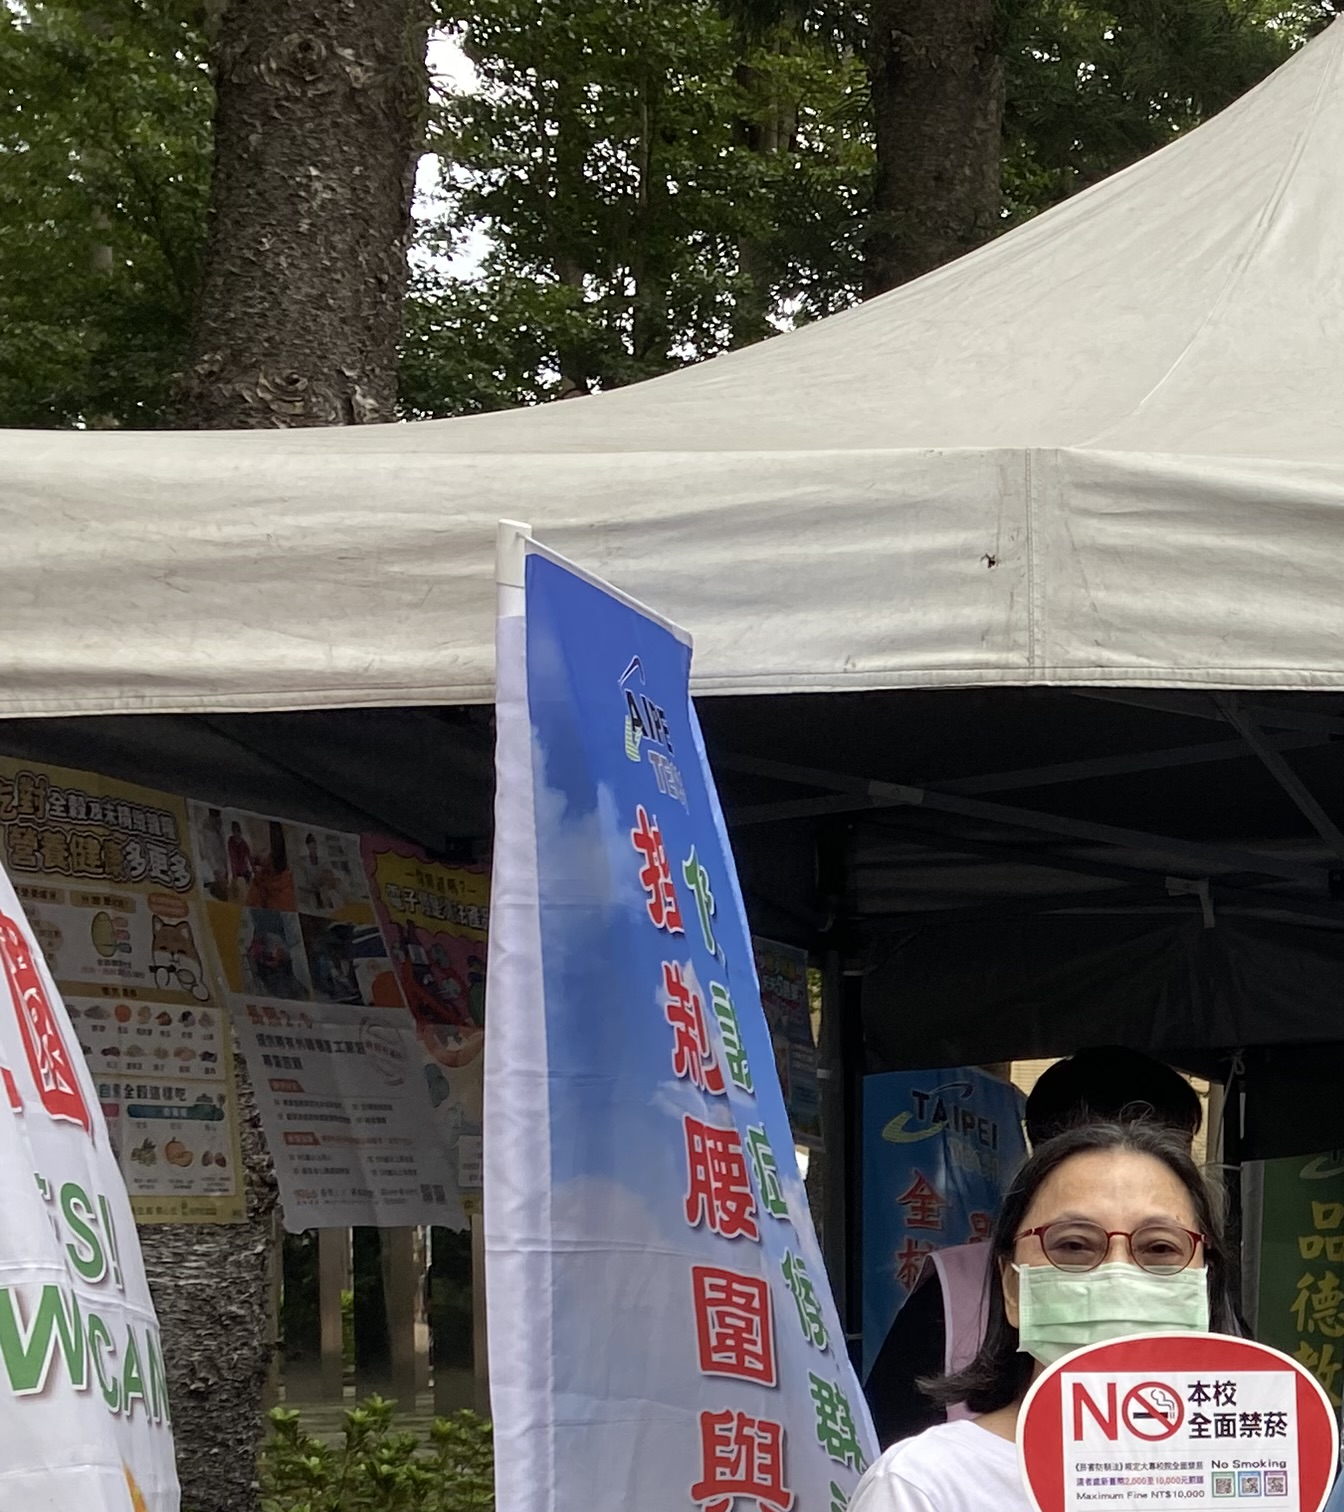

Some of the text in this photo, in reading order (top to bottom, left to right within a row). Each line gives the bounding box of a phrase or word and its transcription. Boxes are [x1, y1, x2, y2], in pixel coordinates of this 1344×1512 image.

[912, 1090, 998, 1150] TAIPEI
[1187, 1380, 1238, 1407] 本校
[1187, 1411, 1289, 1440] 全面禁菸
[1211, 1459, 1288, 1471] No Smoking
[1127, 1490, 1148, 1499] Fine
[1151, 1489, 1205, 1499] NT$10,000
